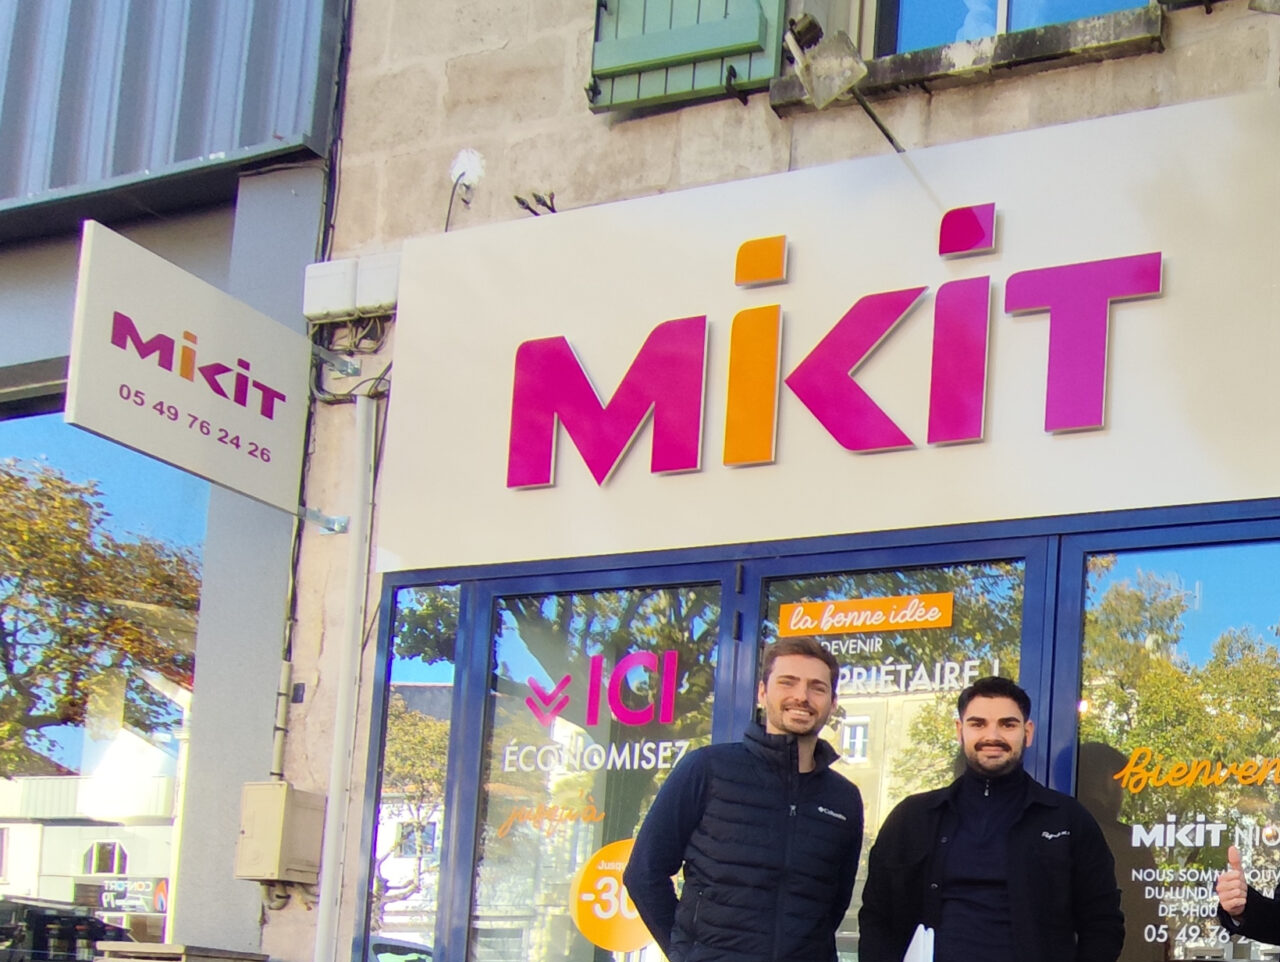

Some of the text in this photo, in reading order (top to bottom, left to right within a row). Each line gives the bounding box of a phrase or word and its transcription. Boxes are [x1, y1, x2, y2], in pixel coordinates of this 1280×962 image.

[118, 384, 272, 463] 05 49 76 24 26
[789, 598, 941, 632] la bonne idée
[586, 649, 679, 727] ICI
[597, 859, 626, 872] Jusq
[1131, 868, 1175, 882] NOUS
[1144, 886, 1214, 899] DU LUNDI
[1158, 904, 1177, 917] DE
[1143, 924, 1169, 943] 05
[1175, 925, 1200, 943] 49
[1208, 925, 1231, 943] 76
